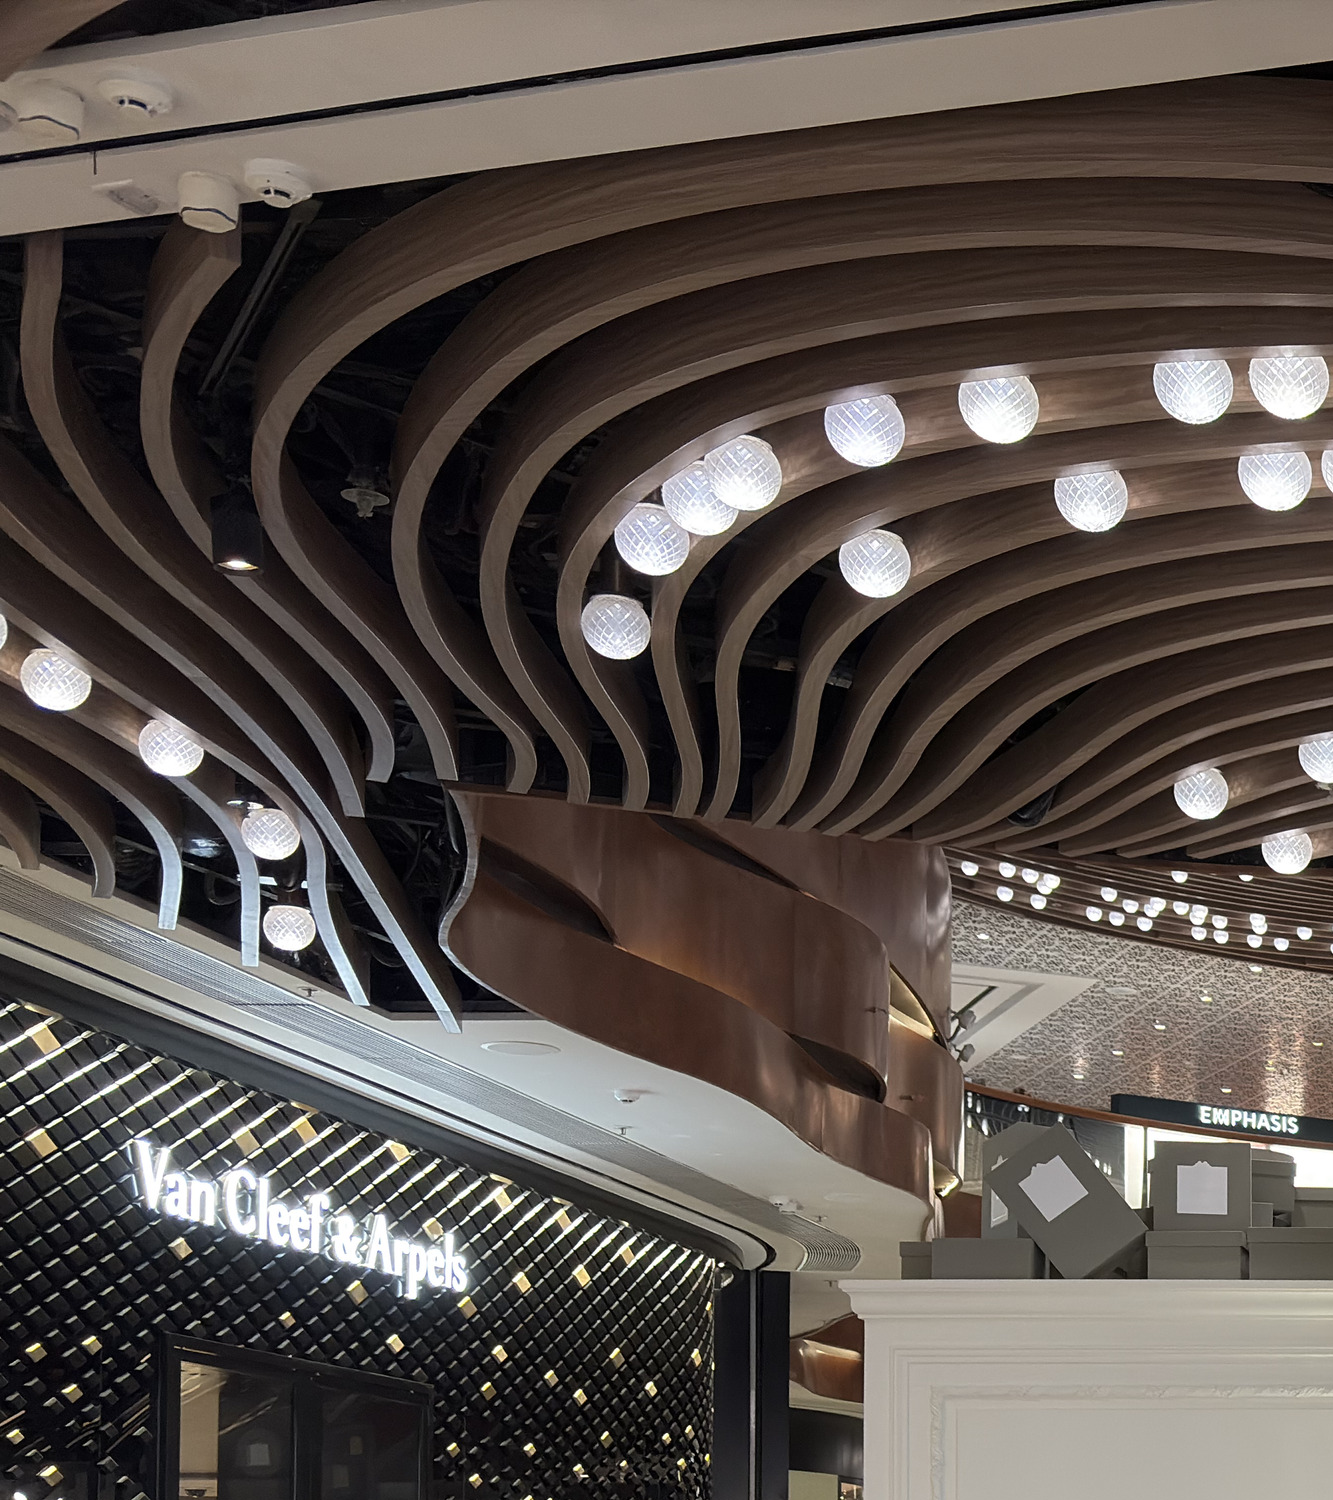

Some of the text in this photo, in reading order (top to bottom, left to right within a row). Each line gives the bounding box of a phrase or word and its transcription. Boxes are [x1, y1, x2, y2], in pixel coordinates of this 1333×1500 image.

[1199, 1105, 1299, 1135] EMPHASIS
[132, 1139, 468, 1301] Van Cleef & Arpels
